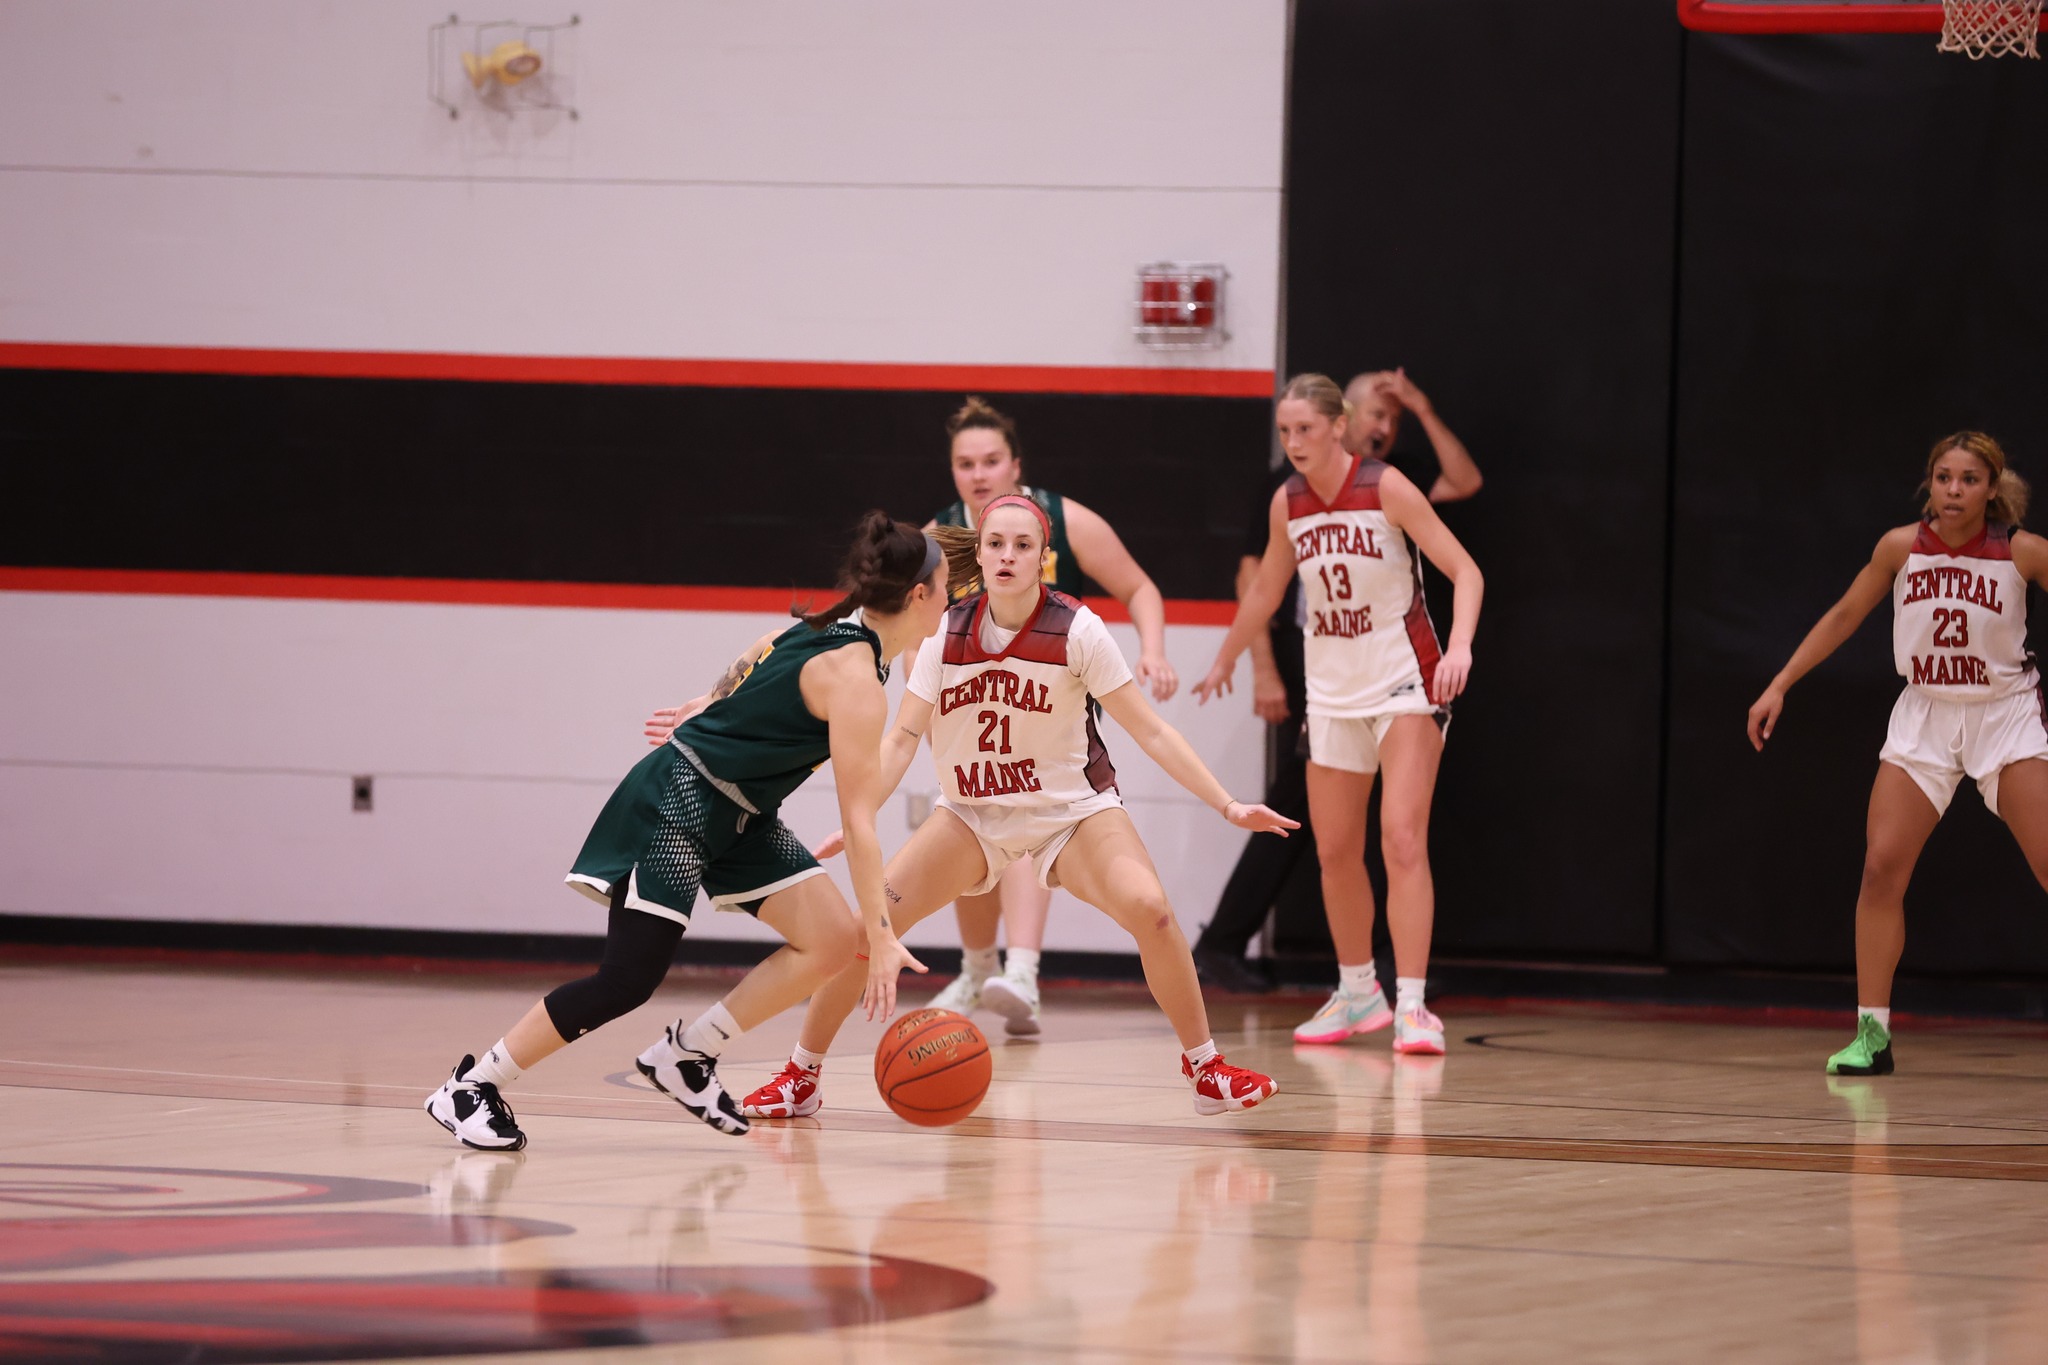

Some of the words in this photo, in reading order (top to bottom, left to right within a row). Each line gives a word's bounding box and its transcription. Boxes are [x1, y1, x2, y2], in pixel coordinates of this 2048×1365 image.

[1297, 523, 1384, 561] ENTRAL
[1319, 563, 1353, 602] 13
[1932, 607, 1969, 648] 23
[1911, 654, 1991, 686] MAINE
[940, 669, 1053, 717] CENTRAL
[978, 710, 1012, 755] 21
[954, 758, 1043, 798] MAINE
[907, 1027, 979, 1067] SPALDING
